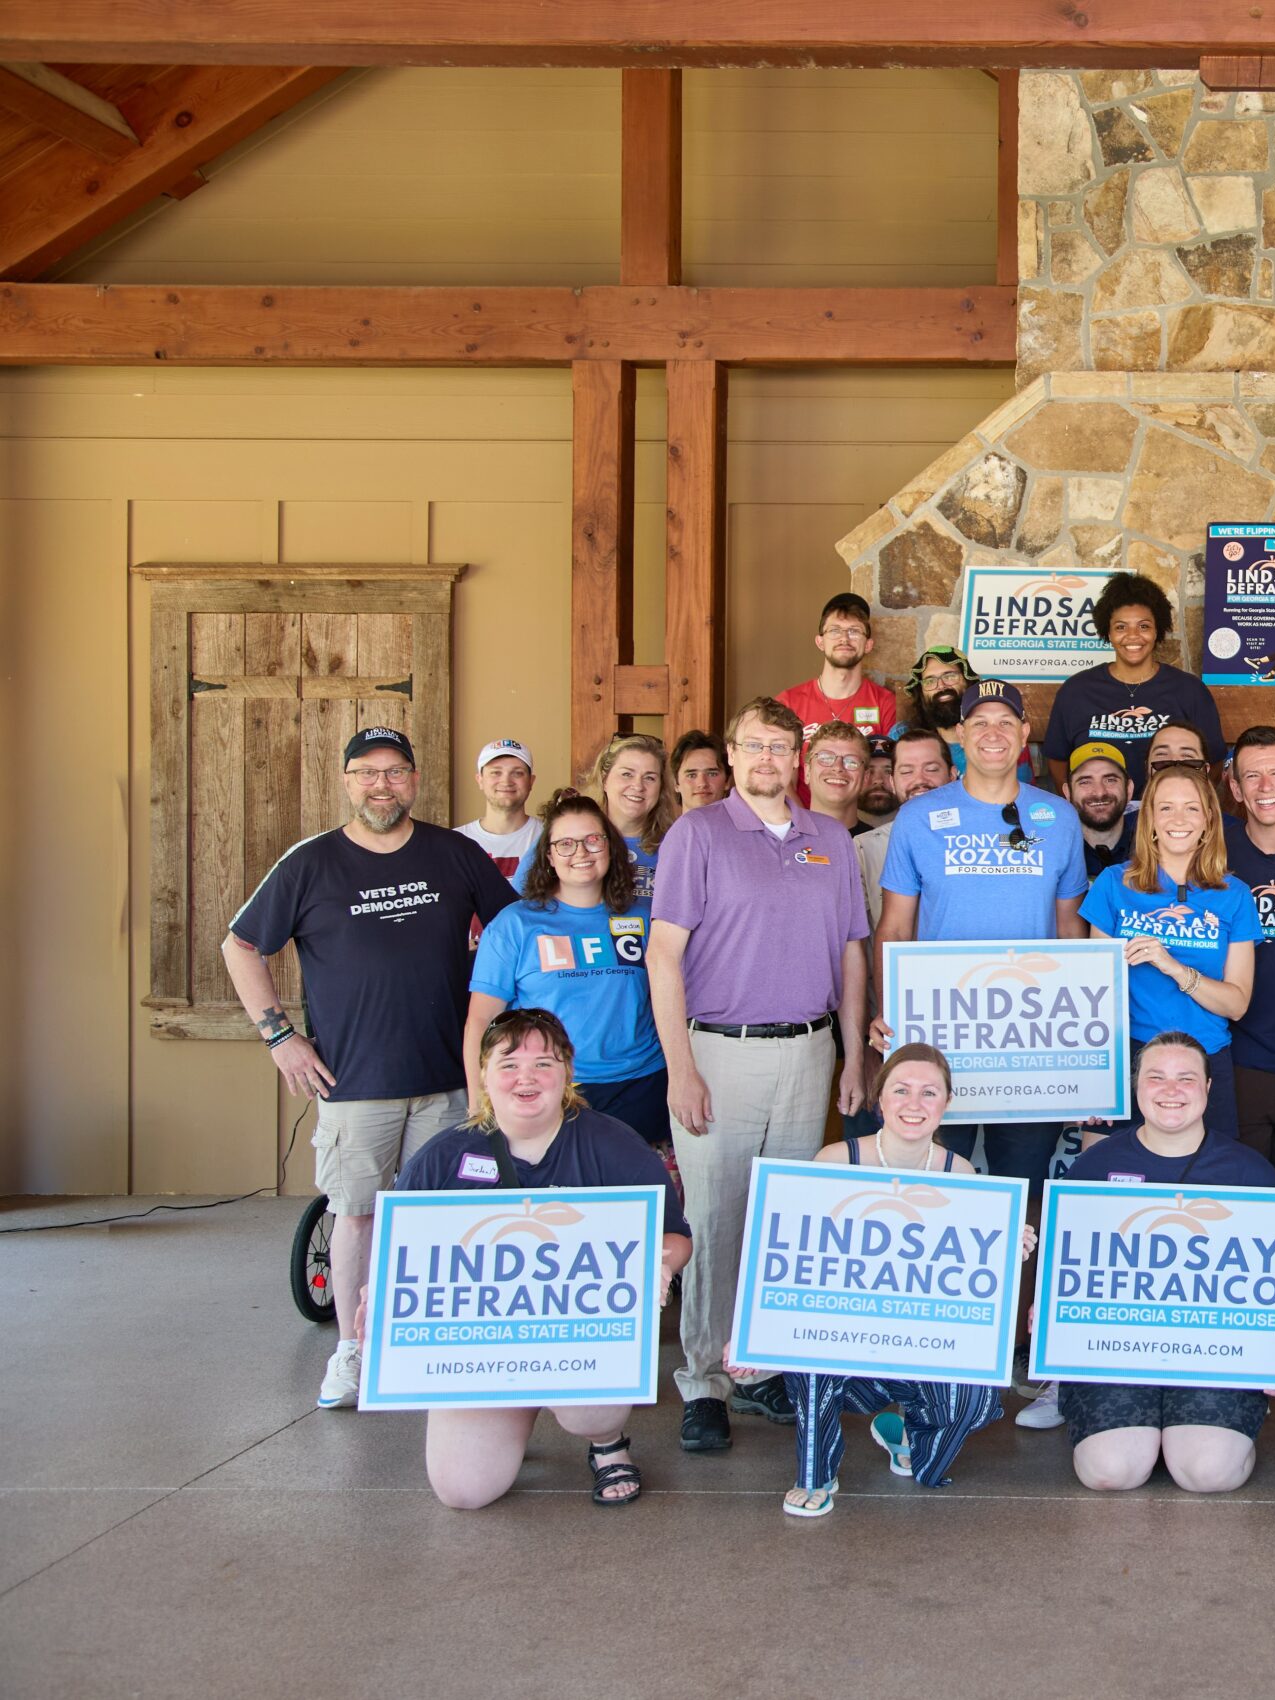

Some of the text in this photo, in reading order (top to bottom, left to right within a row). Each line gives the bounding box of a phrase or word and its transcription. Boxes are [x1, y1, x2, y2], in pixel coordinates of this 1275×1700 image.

[976, 596, 1095, 617] LINDSA
[974, 618, 1097, 636] DEFRANC
[975, 639, 996, 648] FOR
[999, 639, 1044, 648] GEORGIA
[1046, 640, 1077, 649] STATE
[994, 658, 1094, 666] LINDSAYFORGA.COM
[978, 683, 1005, 697] NAVY
[1091, 714, 1171, 727] LINDSAY
[944, 834, 999, 848] TONY
[945, 849, 1043, 866] KOZYCKI
[359, 881, 428, 899] VETS FOR
[350, 893, 440, 915] DEMOCRACY
[558, 969, 589, 979] Lindsay
[905, 986, 1109, 1021] LINDSAY
[905, 1021, 1110, 1050] DEFRANCO
[1011, 1054, 1054, 1069] STATE
[1057, 1053, 1107, 1068] HOUSE
[767, 1212, 1003, 1265] LINDSAY
[395, 1240, 640, 1284] LINDSAY
[762, 1252, 998, 1299] DEFRANCO
[392, 1282, 638, 1319] DEFRANCO
[764, 1291, 991, 1321] FOR GEORGIA STATE HOUSE
[1059, 1305, 1092, 1320] FOR
[1095, 1307, 1167, 1323] GEORGIA
[1170, 1310, 1218, 1324] STATE
[394, 1322, 632, 1341] FOR GEORGIA STATE HOUSE
[793, 1328, 956, 1351] LINDSAYFORGA.COM
[1088, 1339, 1244, 1356] LINDSAYFORGA.COM
[426, 1359, 597, 1375] LINDSAYFORGA.COM
